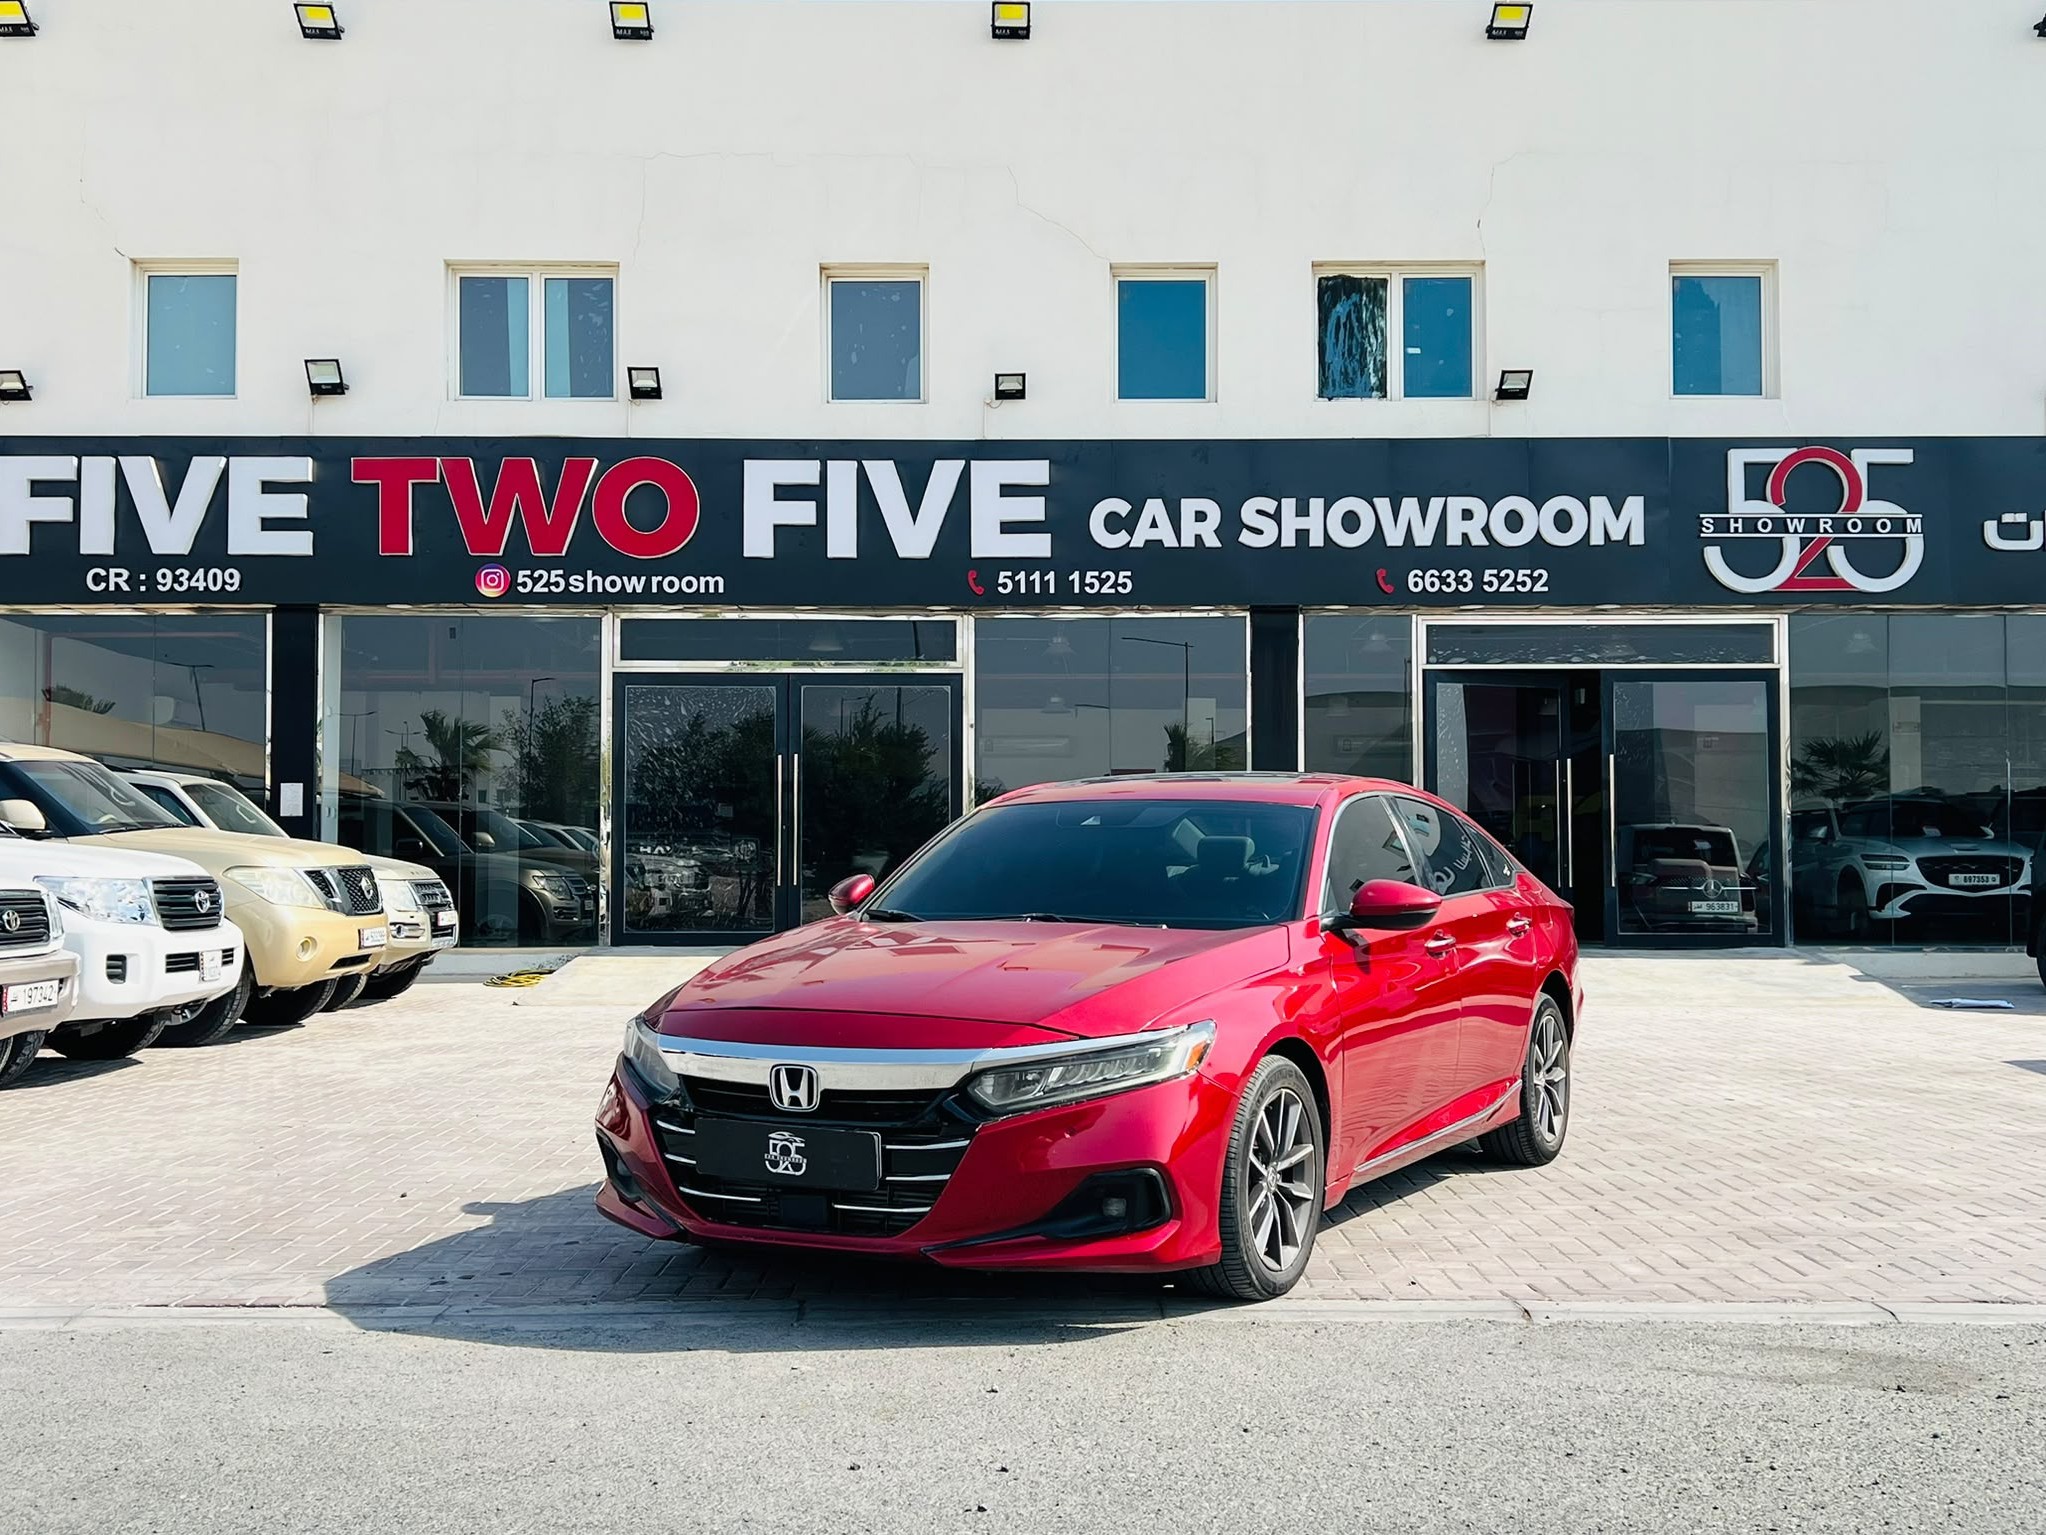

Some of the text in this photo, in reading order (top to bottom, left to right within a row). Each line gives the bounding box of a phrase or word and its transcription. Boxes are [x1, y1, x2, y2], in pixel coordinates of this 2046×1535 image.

[0, 456, 1645, 559] FIVE TWO FIVE CAR SHOWROOM
[1701, 517, 1923, 535] SHOWROOM
[1984, 511, 2046, 551] ت
[86, 567, 131, 592] CR
[156, 567, 241, 592] 93409
[997, 570, 1133, 594] 5111 1525
[1407, 568, 1549, 593] 6633 5252
[23, 984, 54, 1005] 197342
